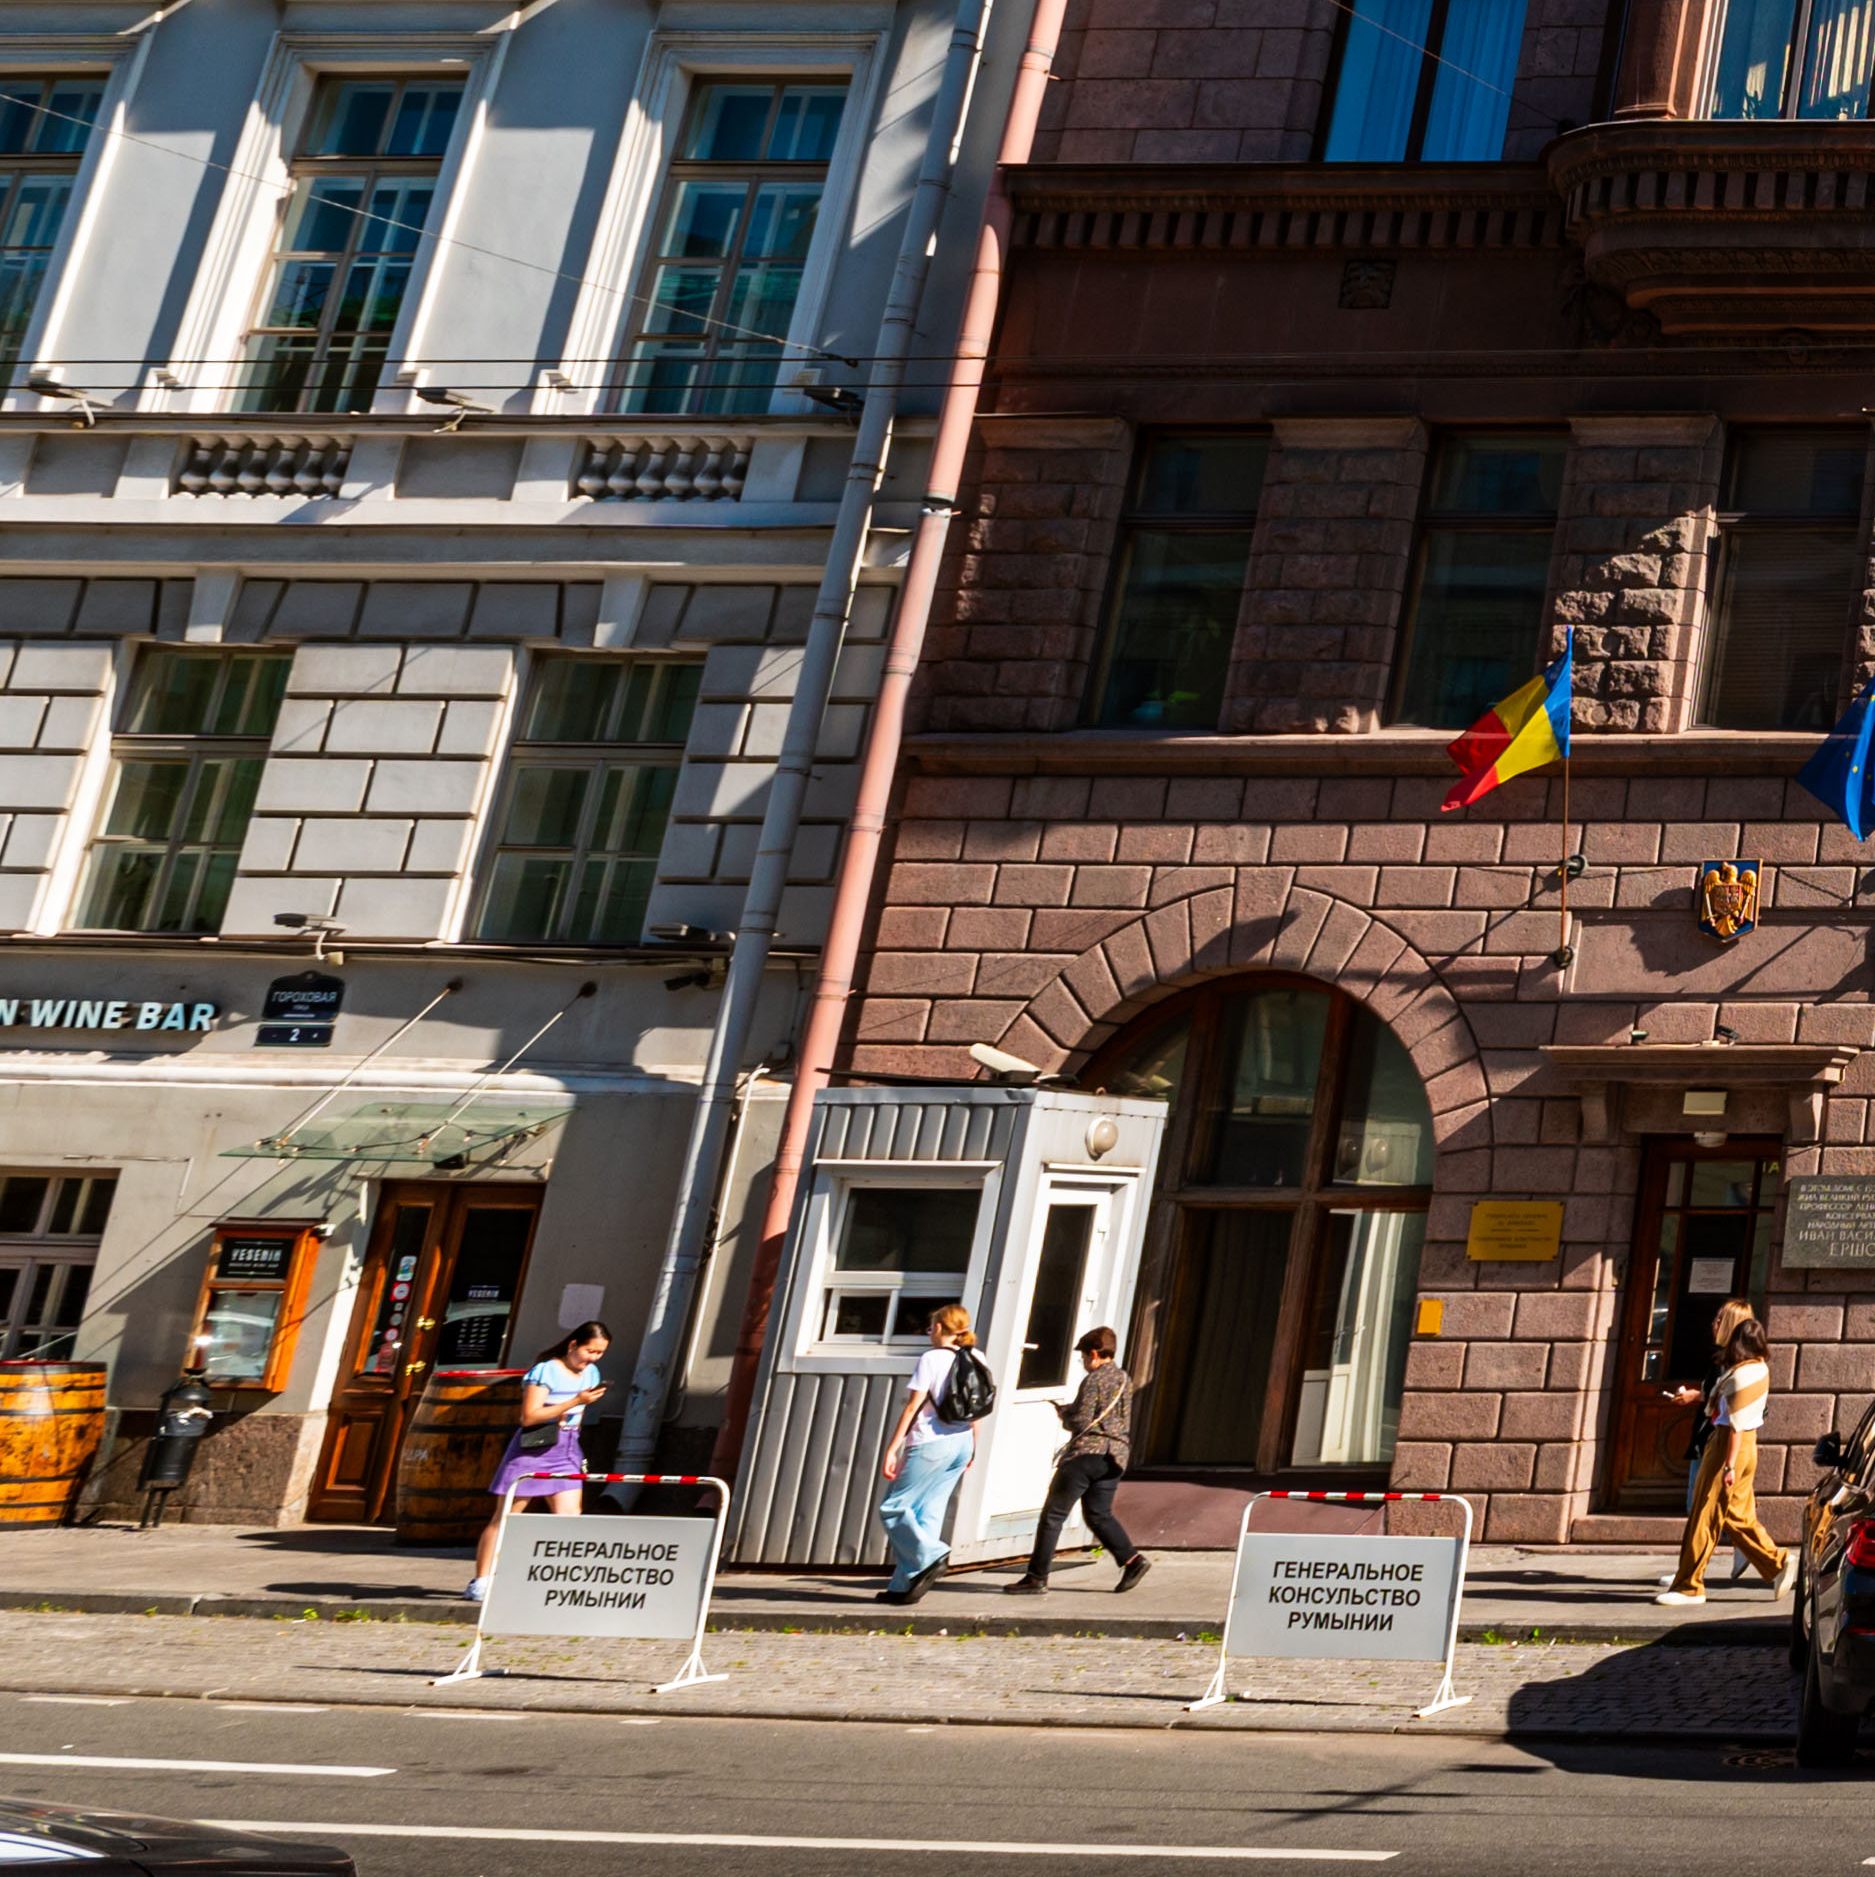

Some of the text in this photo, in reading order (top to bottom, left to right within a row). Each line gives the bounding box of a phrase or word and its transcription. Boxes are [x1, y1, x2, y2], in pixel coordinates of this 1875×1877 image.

[271, 991, 337, 1002] ГОРОХОВАЯ
[31, 1000, 129, 1029] WINE
[135, 1002, 215, 1031] BAR
[289, 1028, 300, 1041] 2
[1799, 1230, 1836, 1241] ИВАН
[533, 1540, 680, 1562] ГЕНЕРАЛЬНОЕ
[527, 1564, 675, 1586] КОНСУЛЬСТВО
[1273, 1560, 1425, 1582] ГЕНЕРАЛЬНОЕ
[544, 1589, 647, 1610] РУМЫНИИ
[1268, 1585, 1421, 1607] КОНСУЛЬСТВО
[1287, 1611, 1394, 1632] РУМЫНИИ
